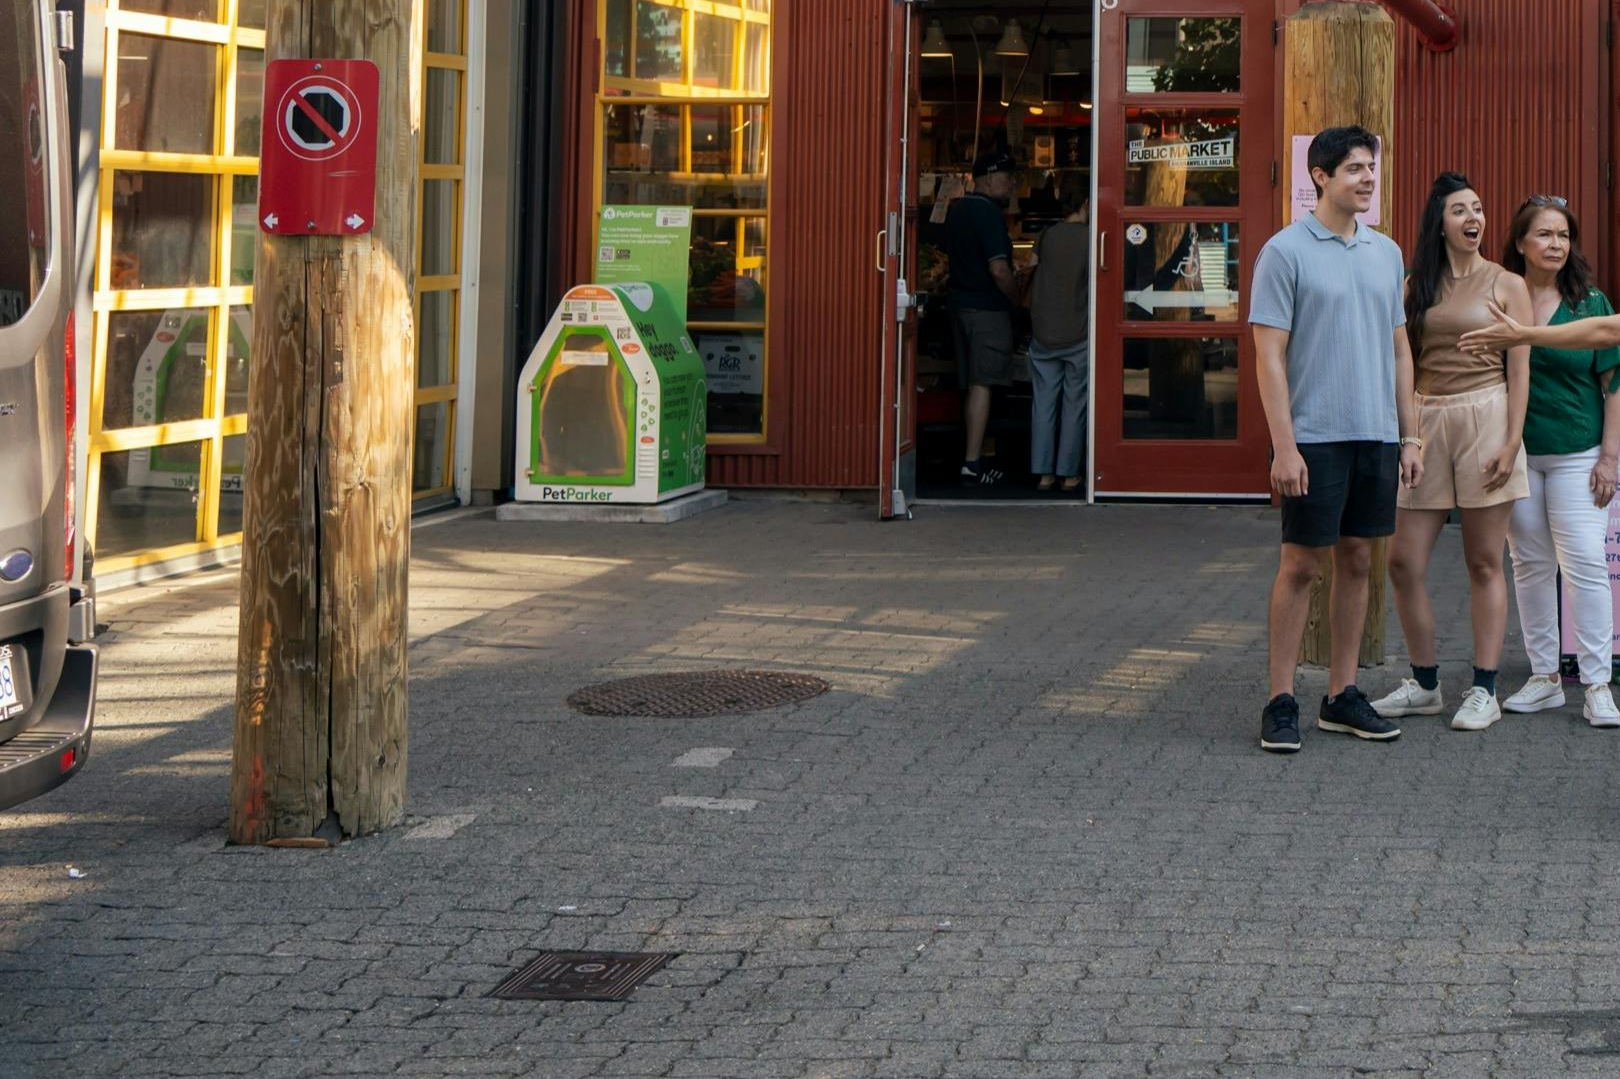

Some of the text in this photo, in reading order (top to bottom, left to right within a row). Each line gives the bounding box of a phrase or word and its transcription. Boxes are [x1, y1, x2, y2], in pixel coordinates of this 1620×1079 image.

[1130, 140, 1231, 161] PUBLIC MARKET
[542, 486, 614, 501] PetParker
